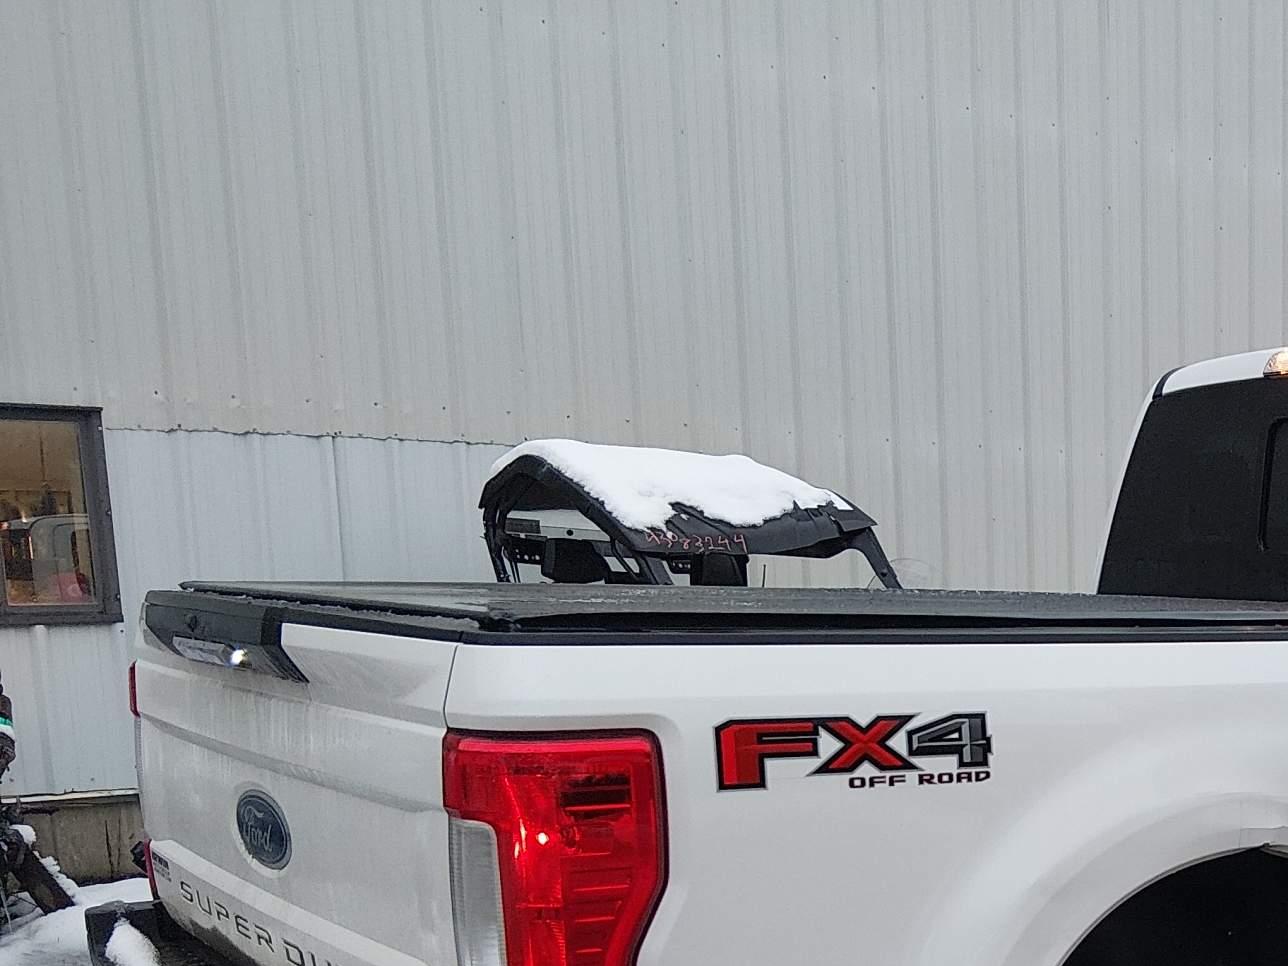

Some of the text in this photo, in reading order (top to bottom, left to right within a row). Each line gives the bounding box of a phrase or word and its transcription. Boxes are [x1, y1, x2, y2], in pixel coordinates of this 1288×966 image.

[713, 711, 993, 793] FX4
[849, 770, 992, 789] OFF ROAD
[242, 804, 274, 854] Ford
[179, 880, 275, 953] SUPER
